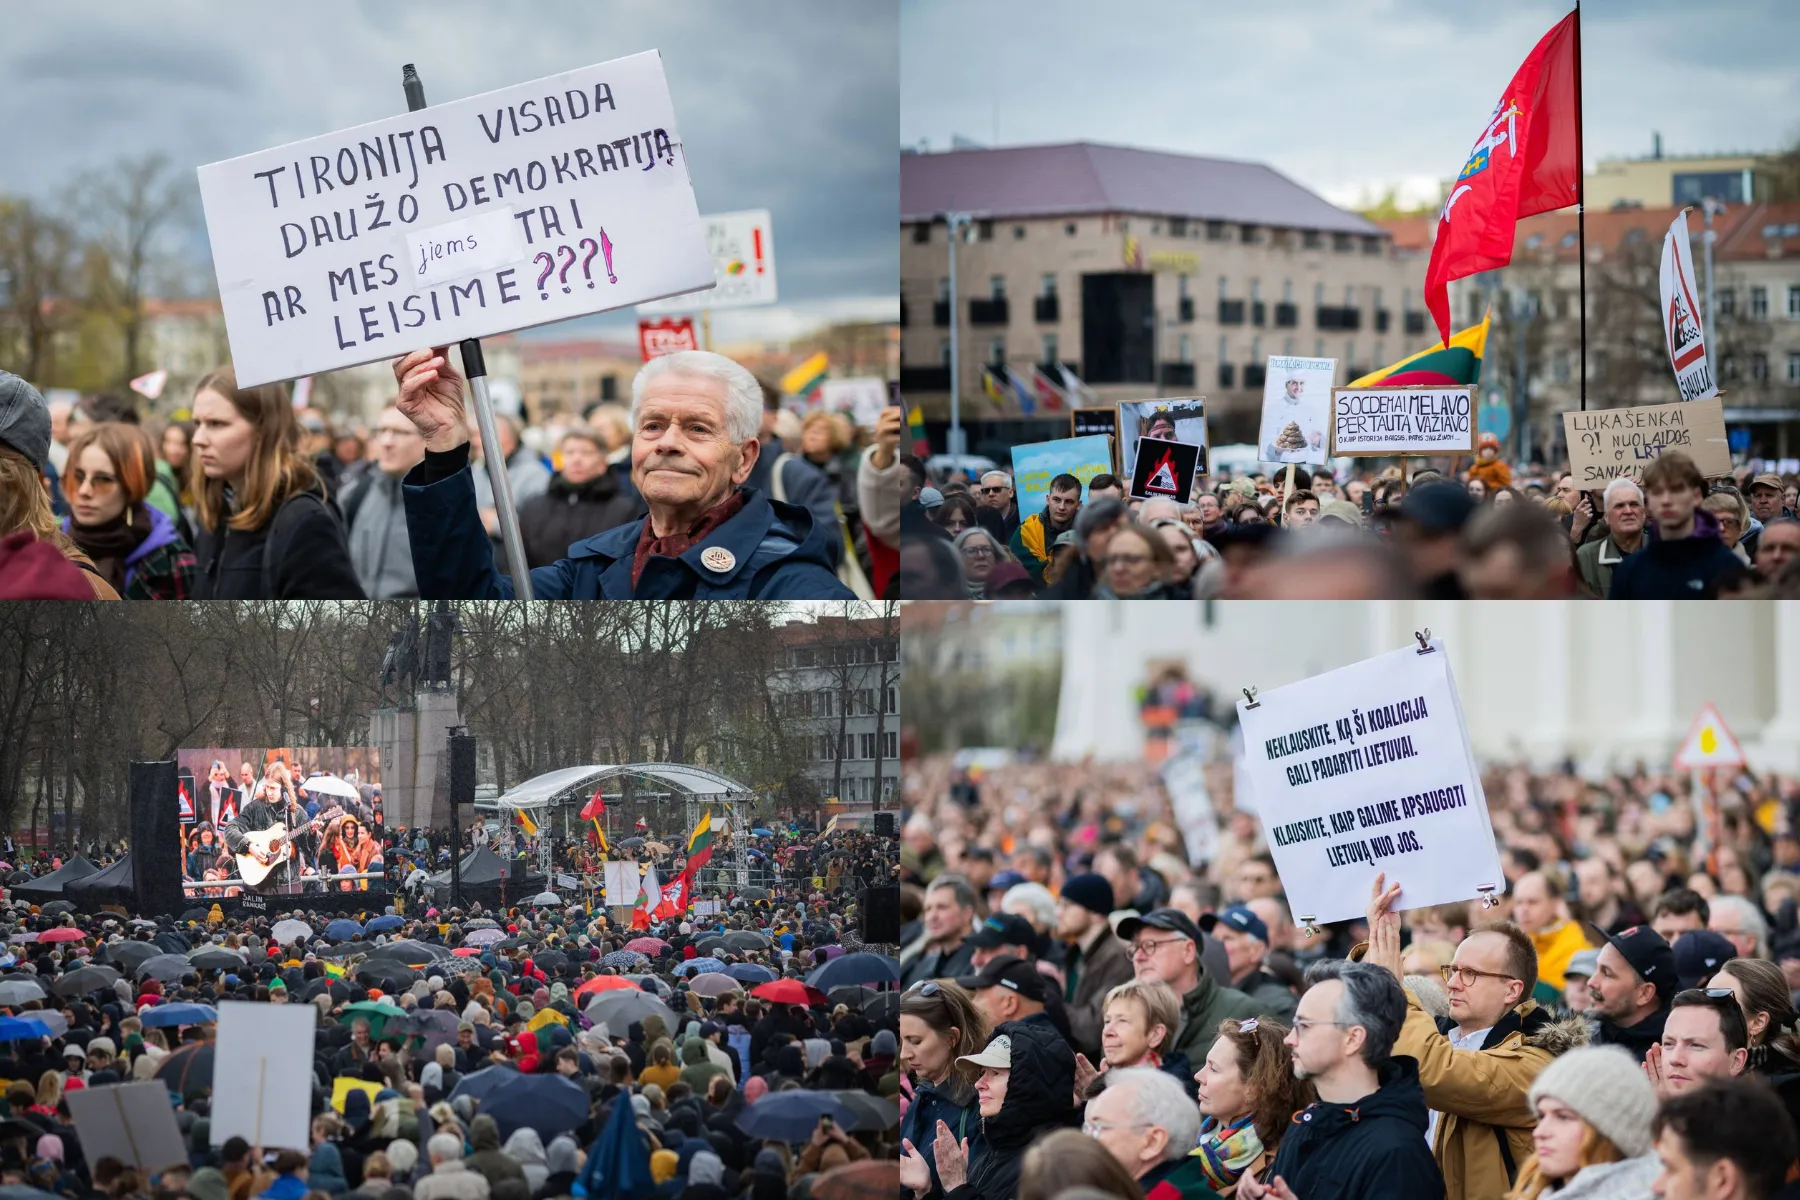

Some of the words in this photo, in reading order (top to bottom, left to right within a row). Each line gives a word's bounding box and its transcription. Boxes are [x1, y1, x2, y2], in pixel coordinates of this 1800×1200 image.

[254, 126, 446, 208] TIRONIJA
[478, 83, 616, 143] VISADA
[280, 193, 419, 259] DAUŽO
[262, 285, 307, 326] AR
[328, 254, 398, 302] MES
[419, 235, 478, 275] jiems
[514, 199, 583, 244] TAI
[1337, 416, 1367, 434] PER
[1368, 415, 1412, 434] TAUTĄ
[1338, 396, 1406, 416] SOCDEMAI
[1409, 395, 1470, 416] MELAVO
[1573, 409, 1684, 431] LUKAŠENKAI
[1634, 444, 1667, 459] LRT
[1265, 723, 1336, 760] NEKLAUSKITE,
[1336, 717, 1355, 745] KĄ
[1352, 708, 1367, 736] ŠI
[1367, 696, 1428, 732] KOALICIJA
[1286, 762, 1312, 787] GALI
[1311, 748, 1364, 781] PADARYTI
[1364, 735, 1418, 768] LIETUVAI.
[1273, 816, 1331, 847] KLAUSKITE,
[1329, 810, 1355, 834] KAIP
[1357, 800, 1401, 829] GALIME
[1401, 784, 1467, 819] APSAUGOTI
[1326, 840, 1375, 867] LIETUVĄ
[1370, 835, 1395, 858] NUO
[1397, 830, 1424, 851] JOS.
